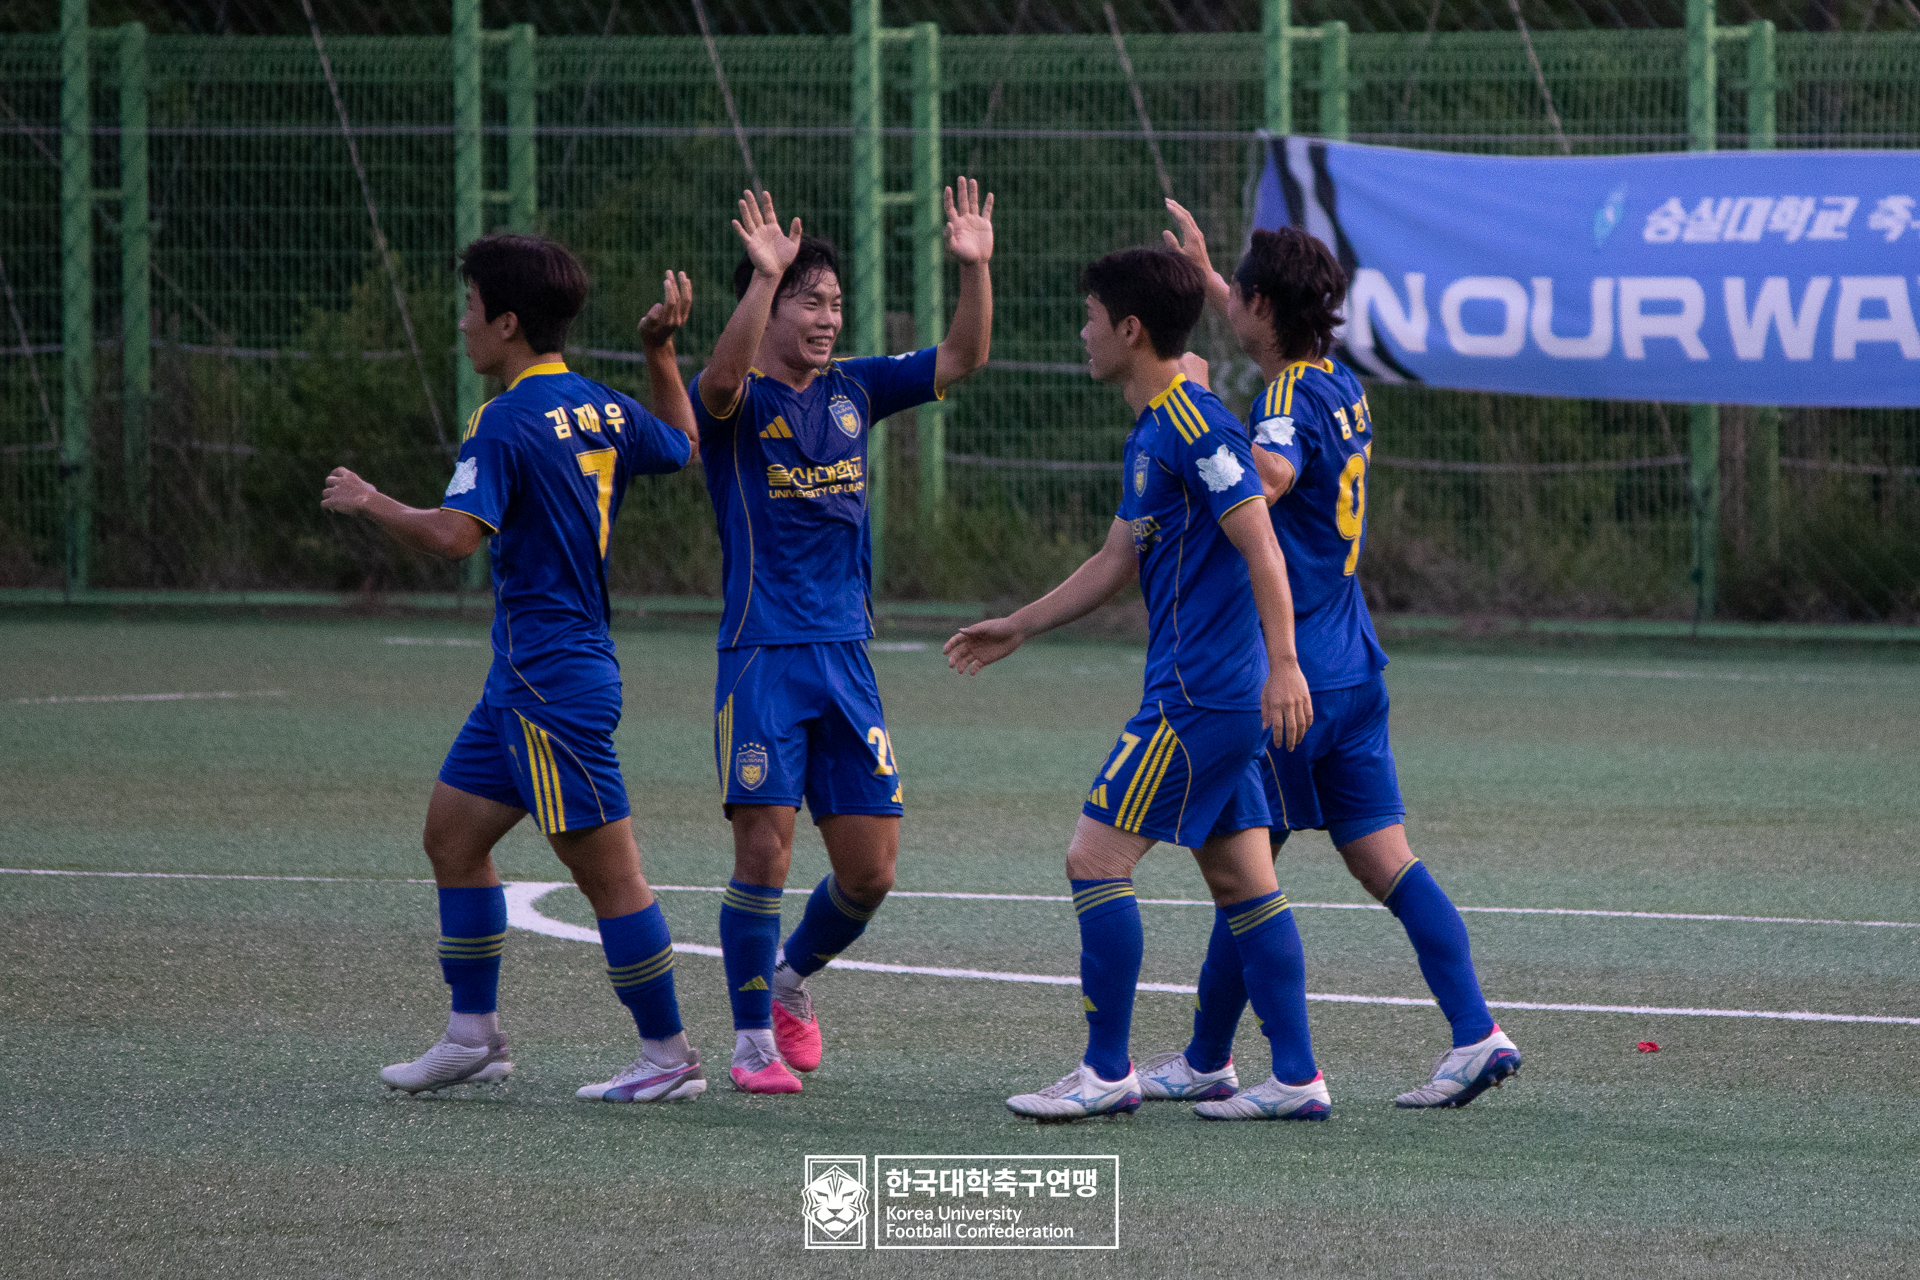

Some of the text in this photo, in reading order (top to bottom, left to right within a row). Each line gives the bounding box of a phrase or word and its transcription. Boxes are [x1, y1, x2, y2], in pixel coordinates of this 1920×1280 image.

[1867, 194, 1920, 243] 축
[1440, 275, 1709, 361] OUR
[1721, 276, 1920, 362] WA
[544, 402, 626, 440] 김재우
[766, 456, 863, 489] 울산대학교
[828, 484, 843, 494] OF
[575, 446, 619, 561] 7
[1335, 441, 1372, 577] 9
